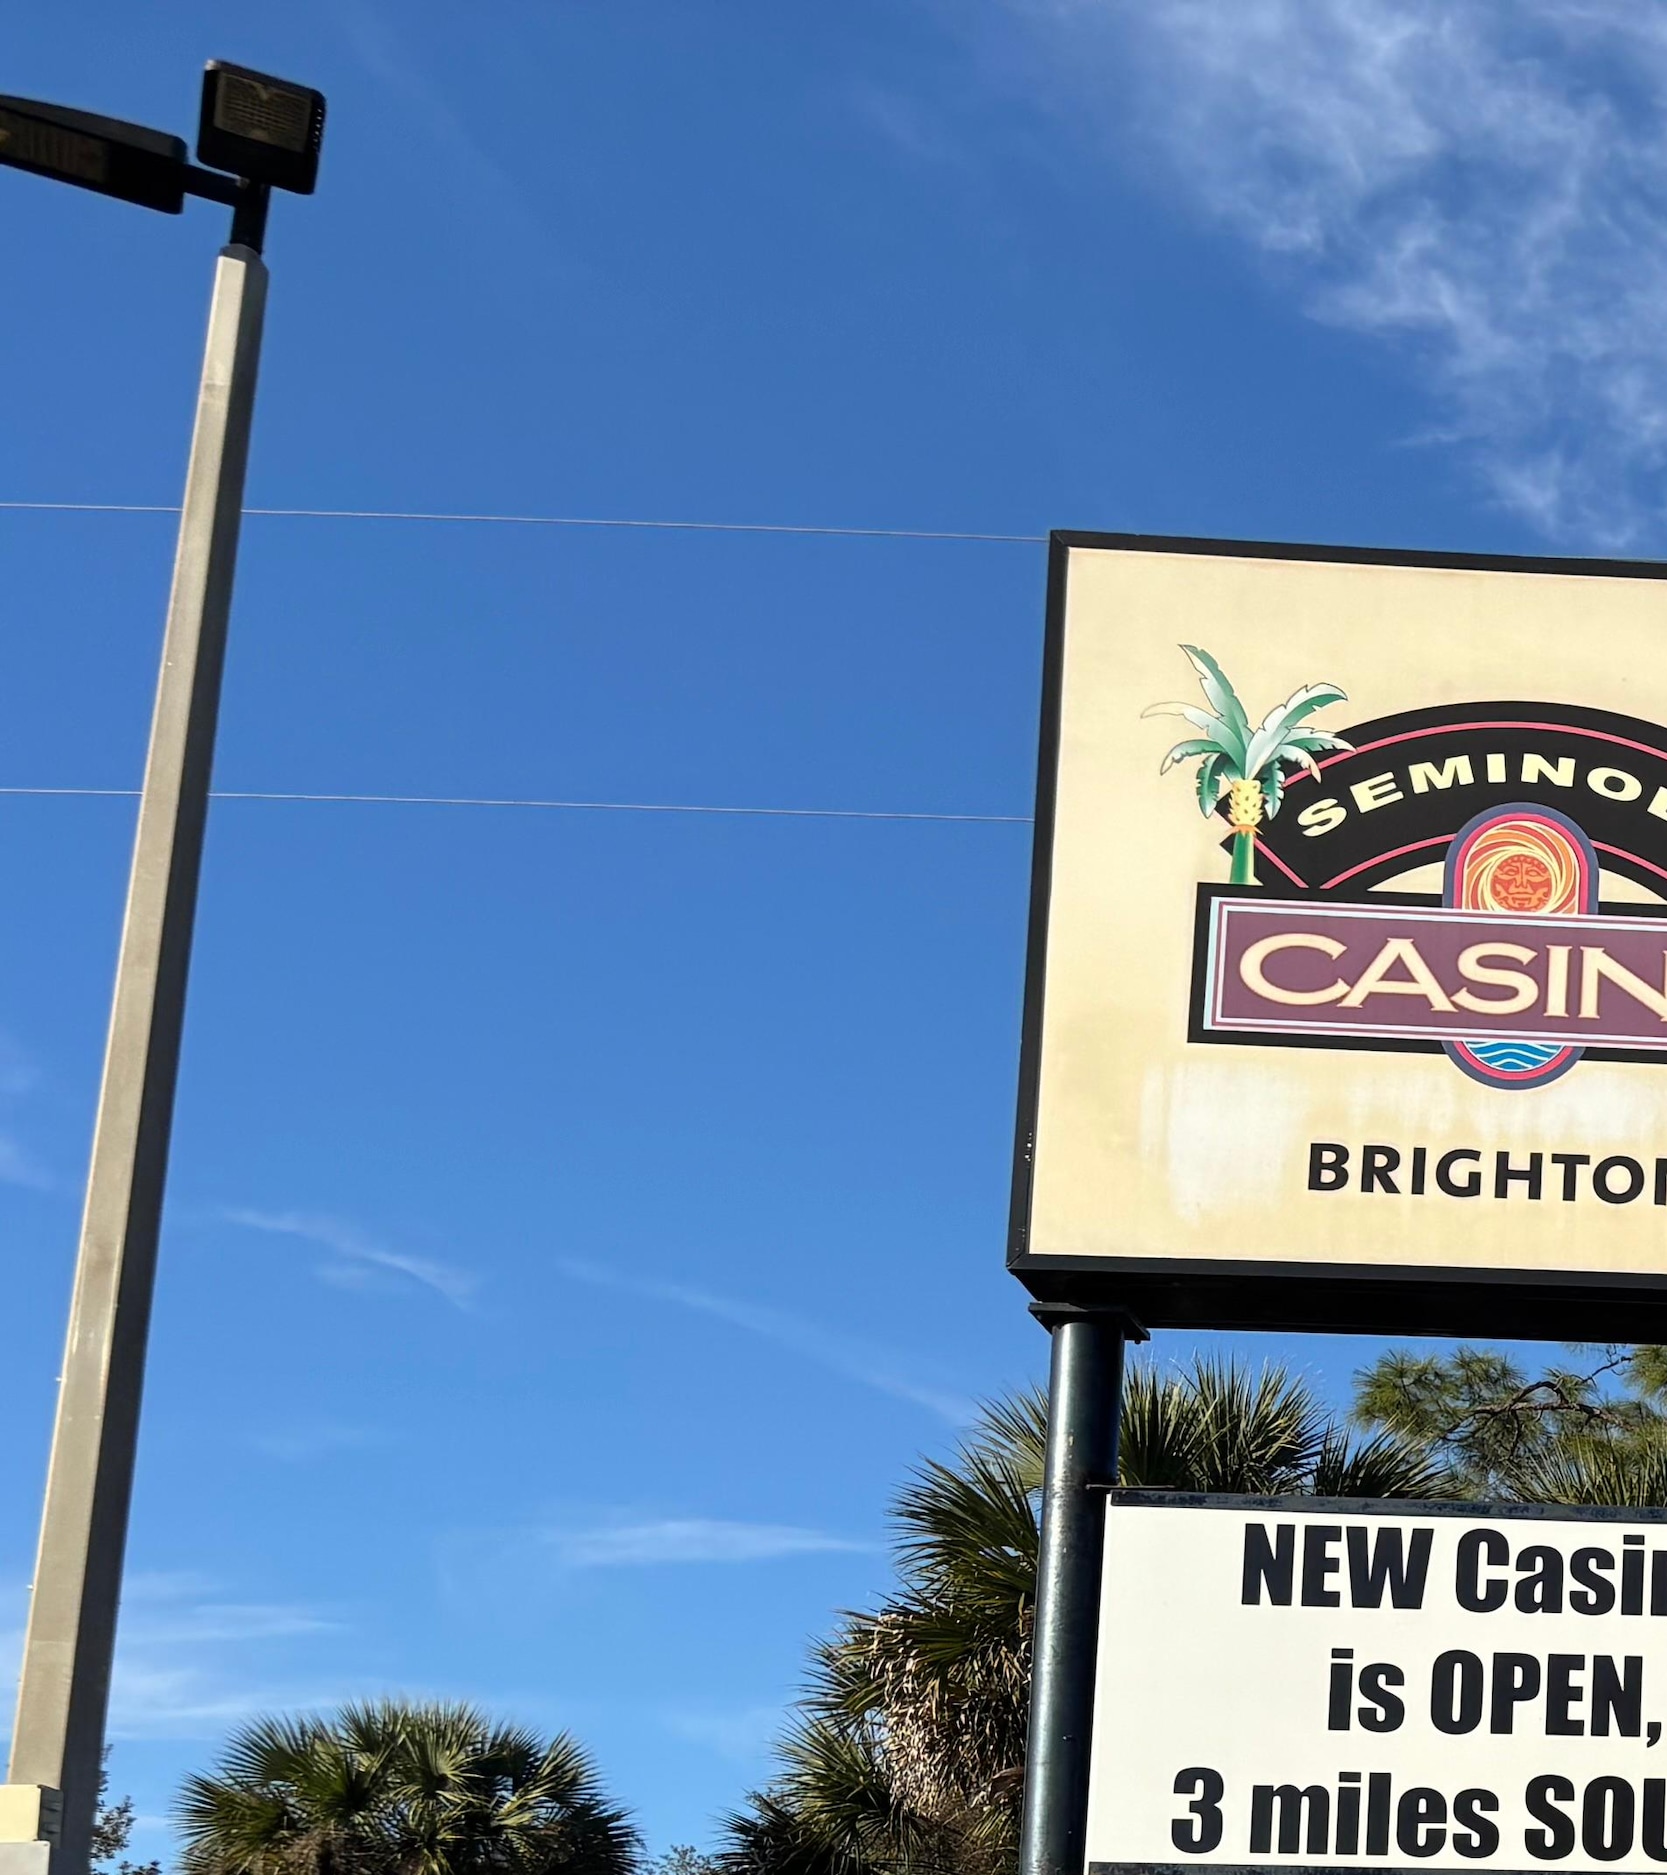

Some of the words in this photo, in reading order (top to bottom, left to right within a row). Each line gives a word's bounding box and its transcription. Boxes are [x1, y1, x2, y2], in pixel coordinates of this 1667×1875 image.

[1242, 1524, 1434, 1609] NEW
[1328, 1648, 1404, 1732] is
[1431, 1650, 1661, 1747] OPEN,
[1172, 1767, 1223, 1853] 3
[1250, 1772, 1499, 1858] miles
